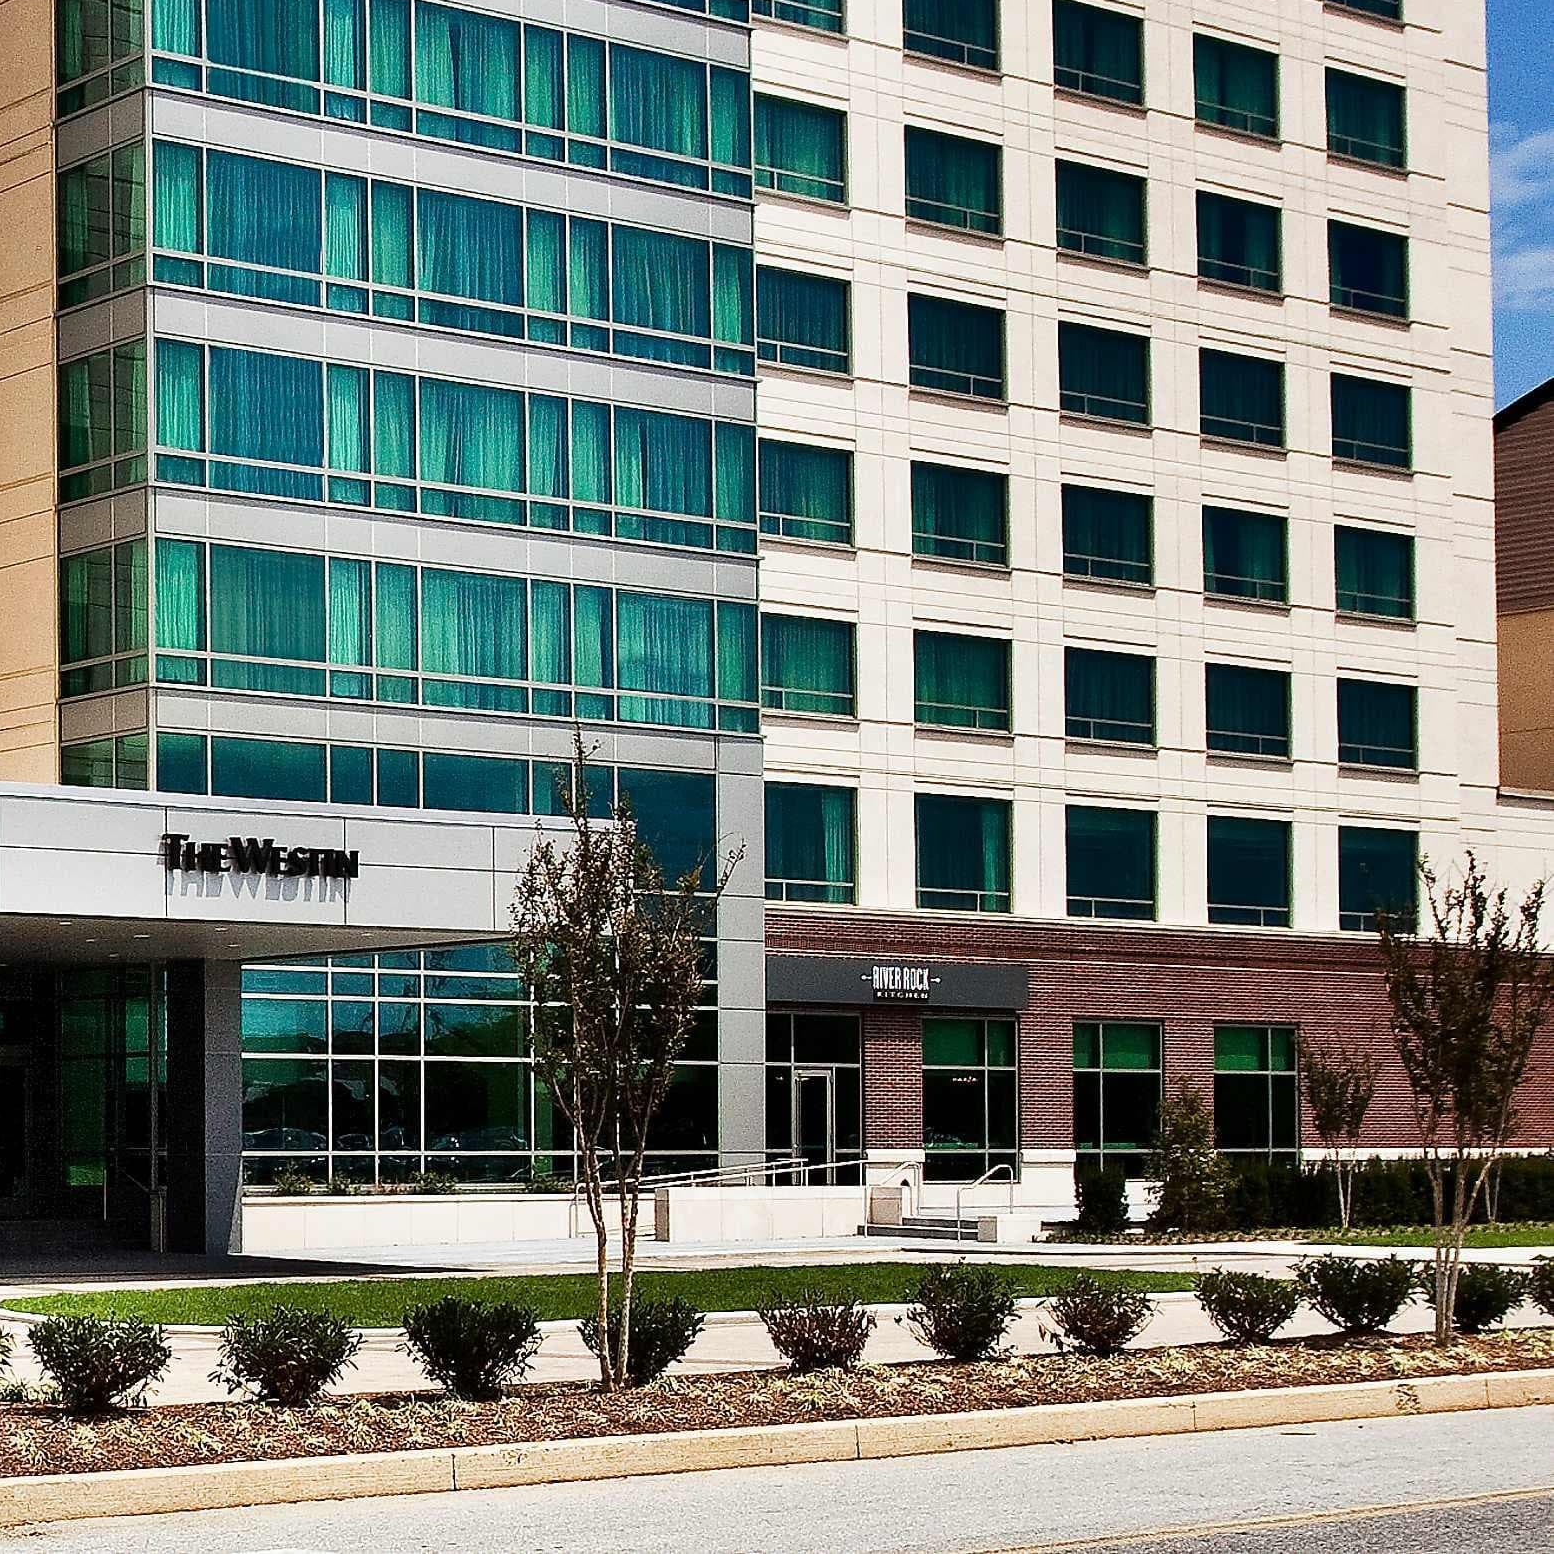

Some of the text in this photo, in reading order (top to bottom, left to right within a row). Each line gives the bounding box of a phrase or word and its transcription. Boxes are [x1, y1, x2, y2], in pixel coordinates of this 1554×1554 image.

[162, 834, 359, 878] THE WESTIN
[872, 966, 930, 991] RIVER ROCK
